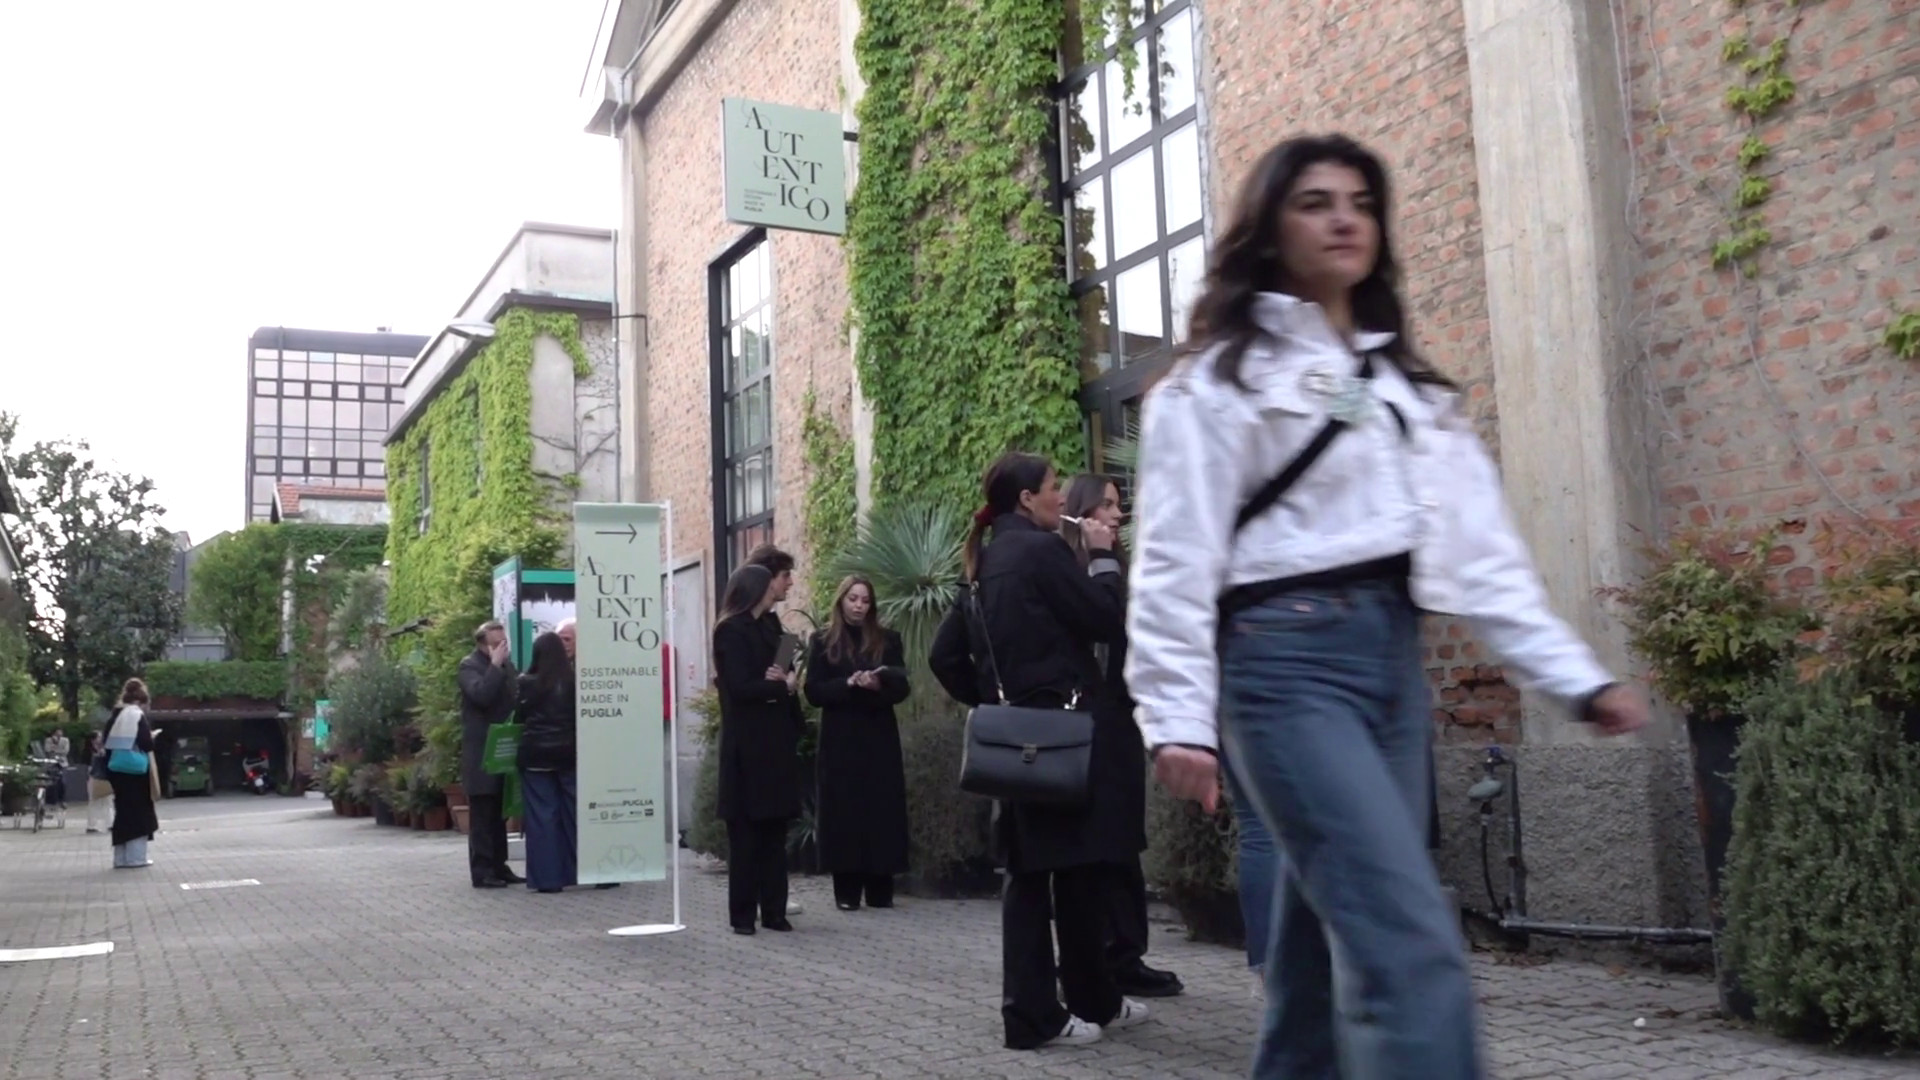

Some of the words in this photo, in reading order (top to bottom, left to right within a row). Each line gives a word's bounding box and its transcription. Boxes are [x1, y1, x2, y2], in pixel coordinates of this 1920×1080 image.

[580, 666, 659, 677] SUSTAINABLE
[580, 680, 623, 690] DESIGN
[580, 694, 613, 704] MADE
[616, 693, 630, 703] IN
[580, 708, 623, 718] PUGLIA
